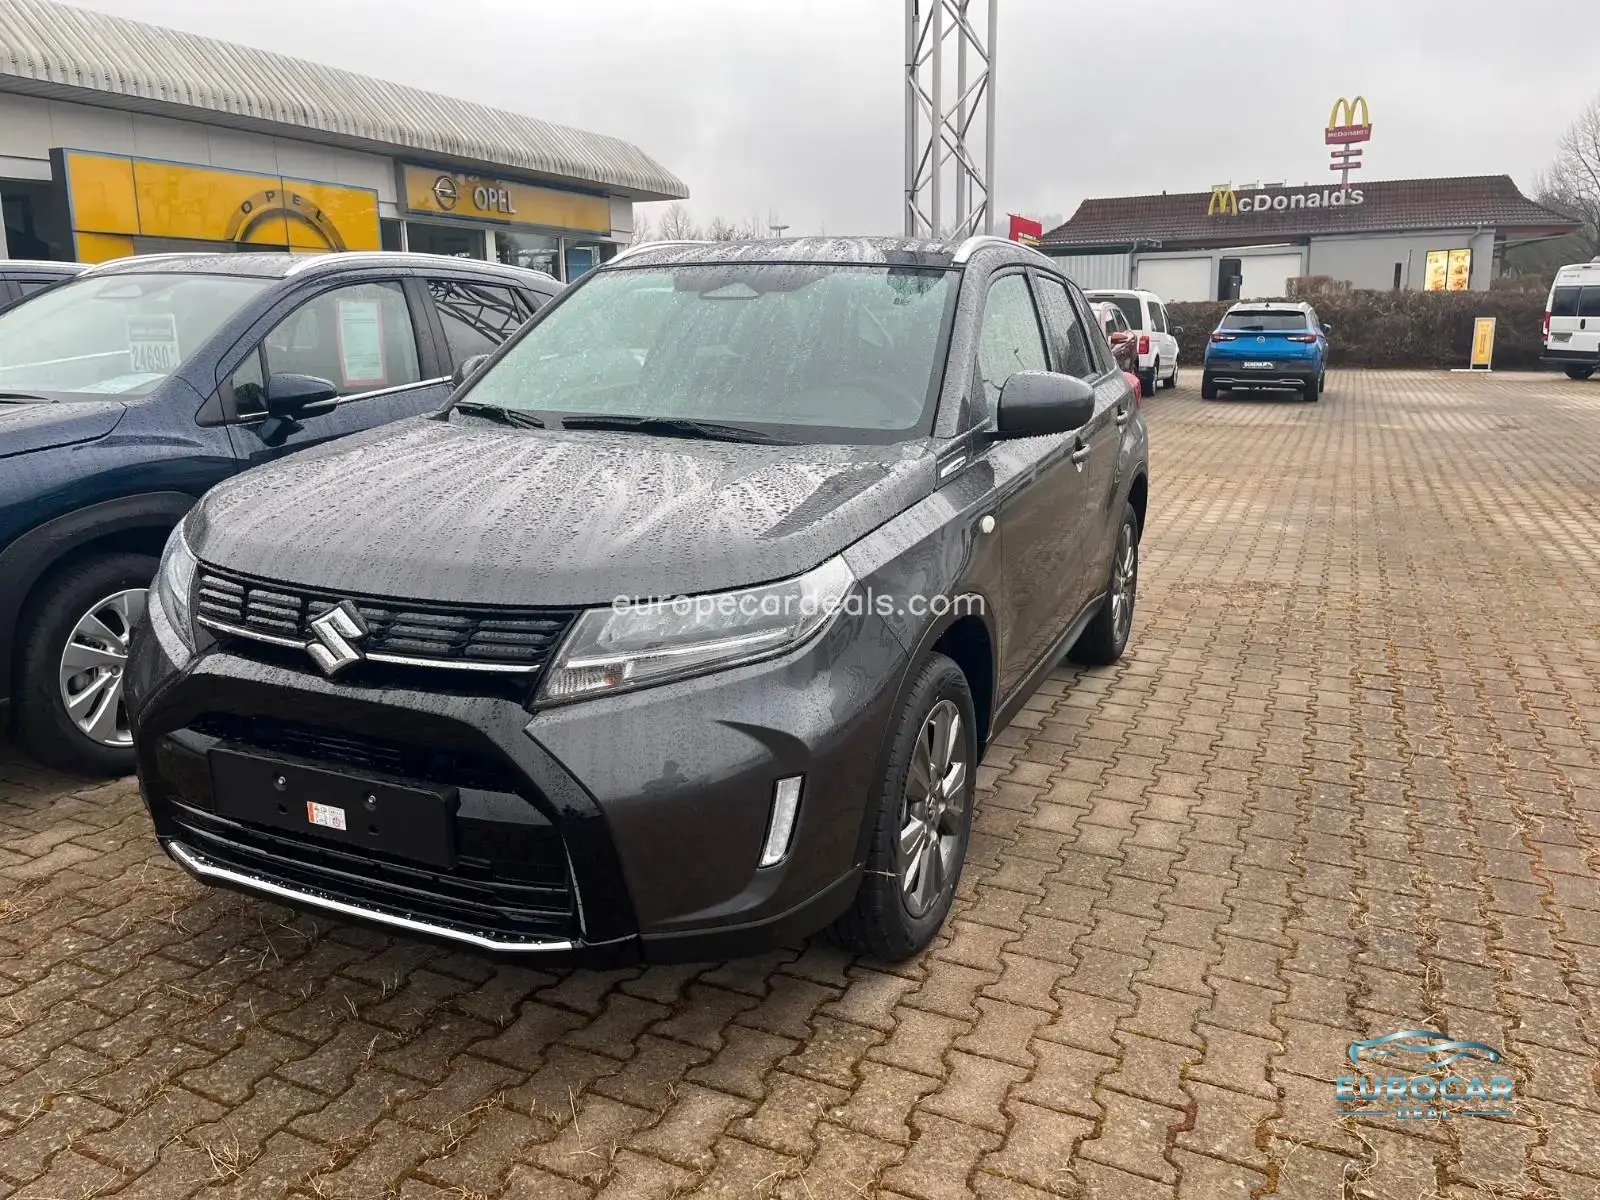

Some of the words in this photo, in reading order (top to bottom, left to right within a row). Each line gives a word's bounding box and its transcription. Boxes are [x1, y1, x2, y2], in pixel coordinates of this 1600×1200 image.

[241, 190, 323, 222] OPEL
[474, 186, 517, 214] OPEL
[1208, 188, 1364, 216] McDonald's
